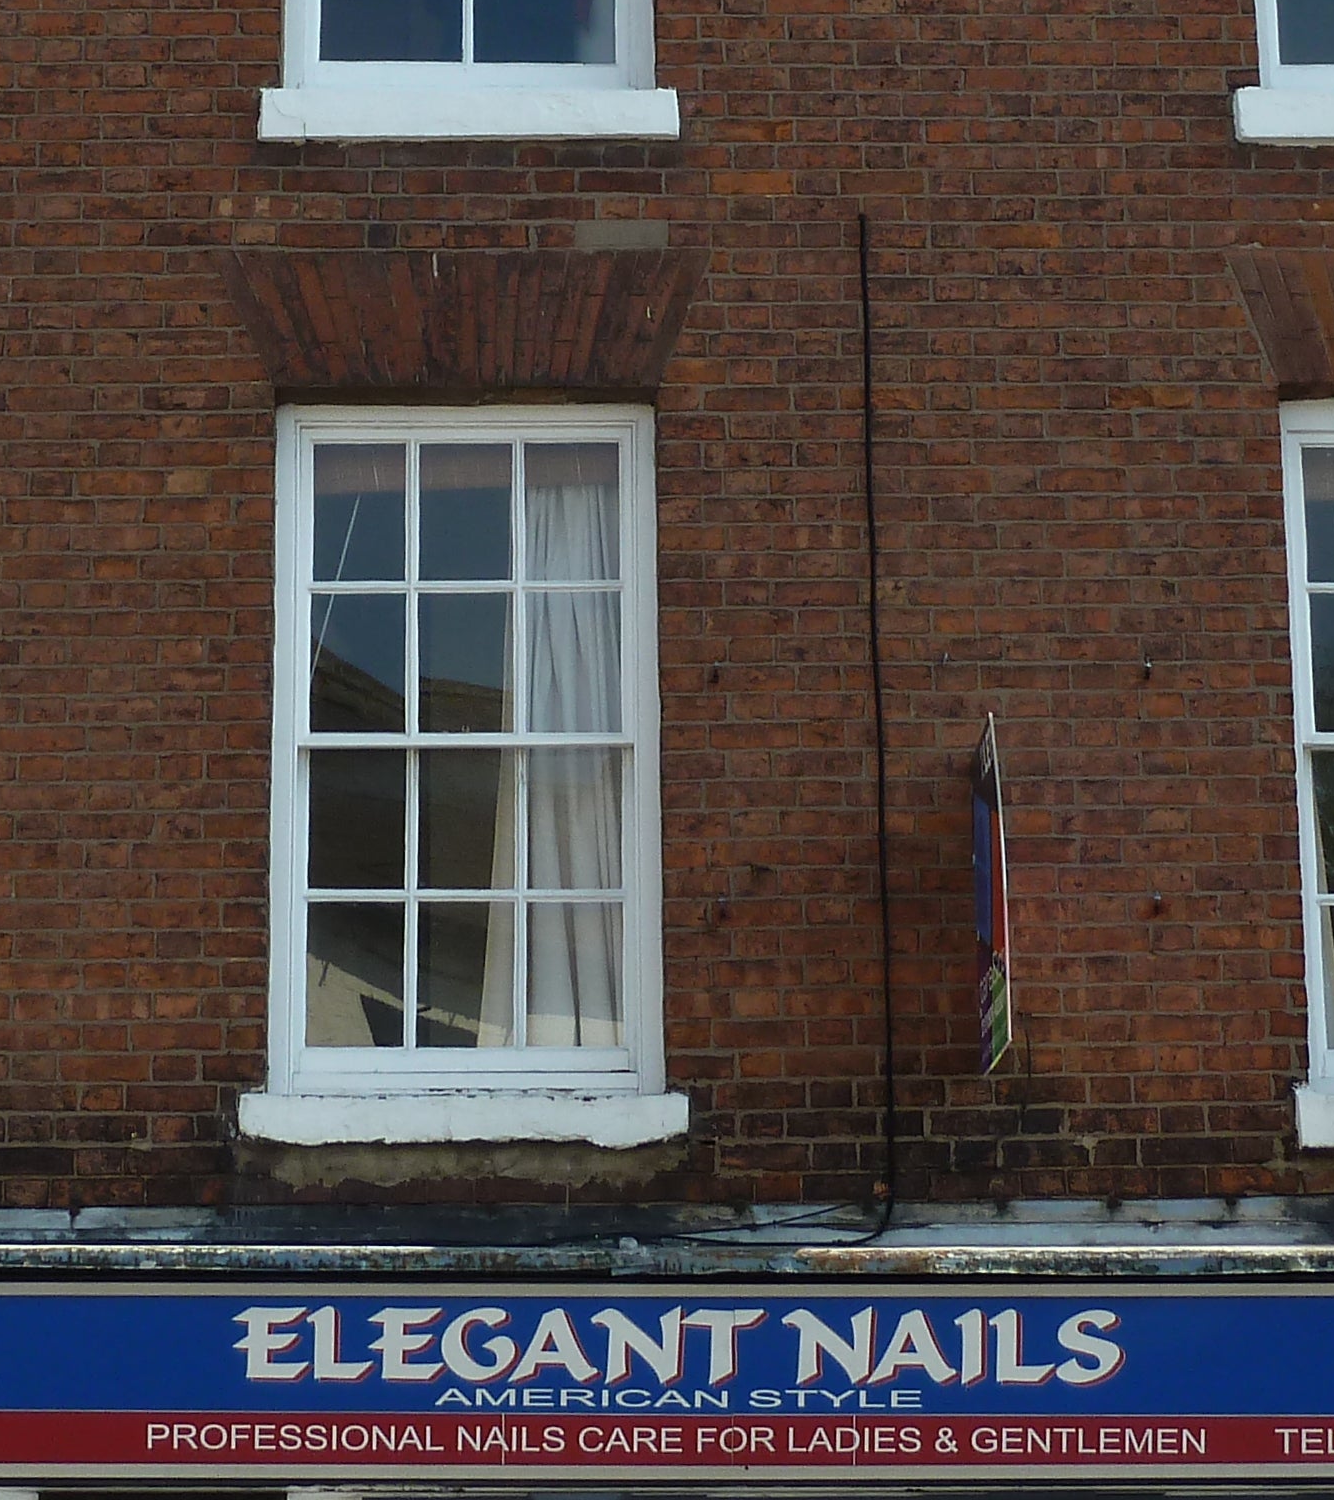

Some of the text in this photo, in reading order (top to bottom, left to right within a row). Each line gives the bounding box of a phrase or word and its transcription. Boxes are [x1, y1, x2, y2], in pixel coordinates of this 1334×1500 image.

[232, 1305, 1126, 1386] ELEGANT NAILS
[434, 1388, 923, 1409] AMERICAN STYLE
[146, 1423, 1206, 1455] PROFESSIONAL NAILS CARE FOR LADIES & GENTLEMEN
